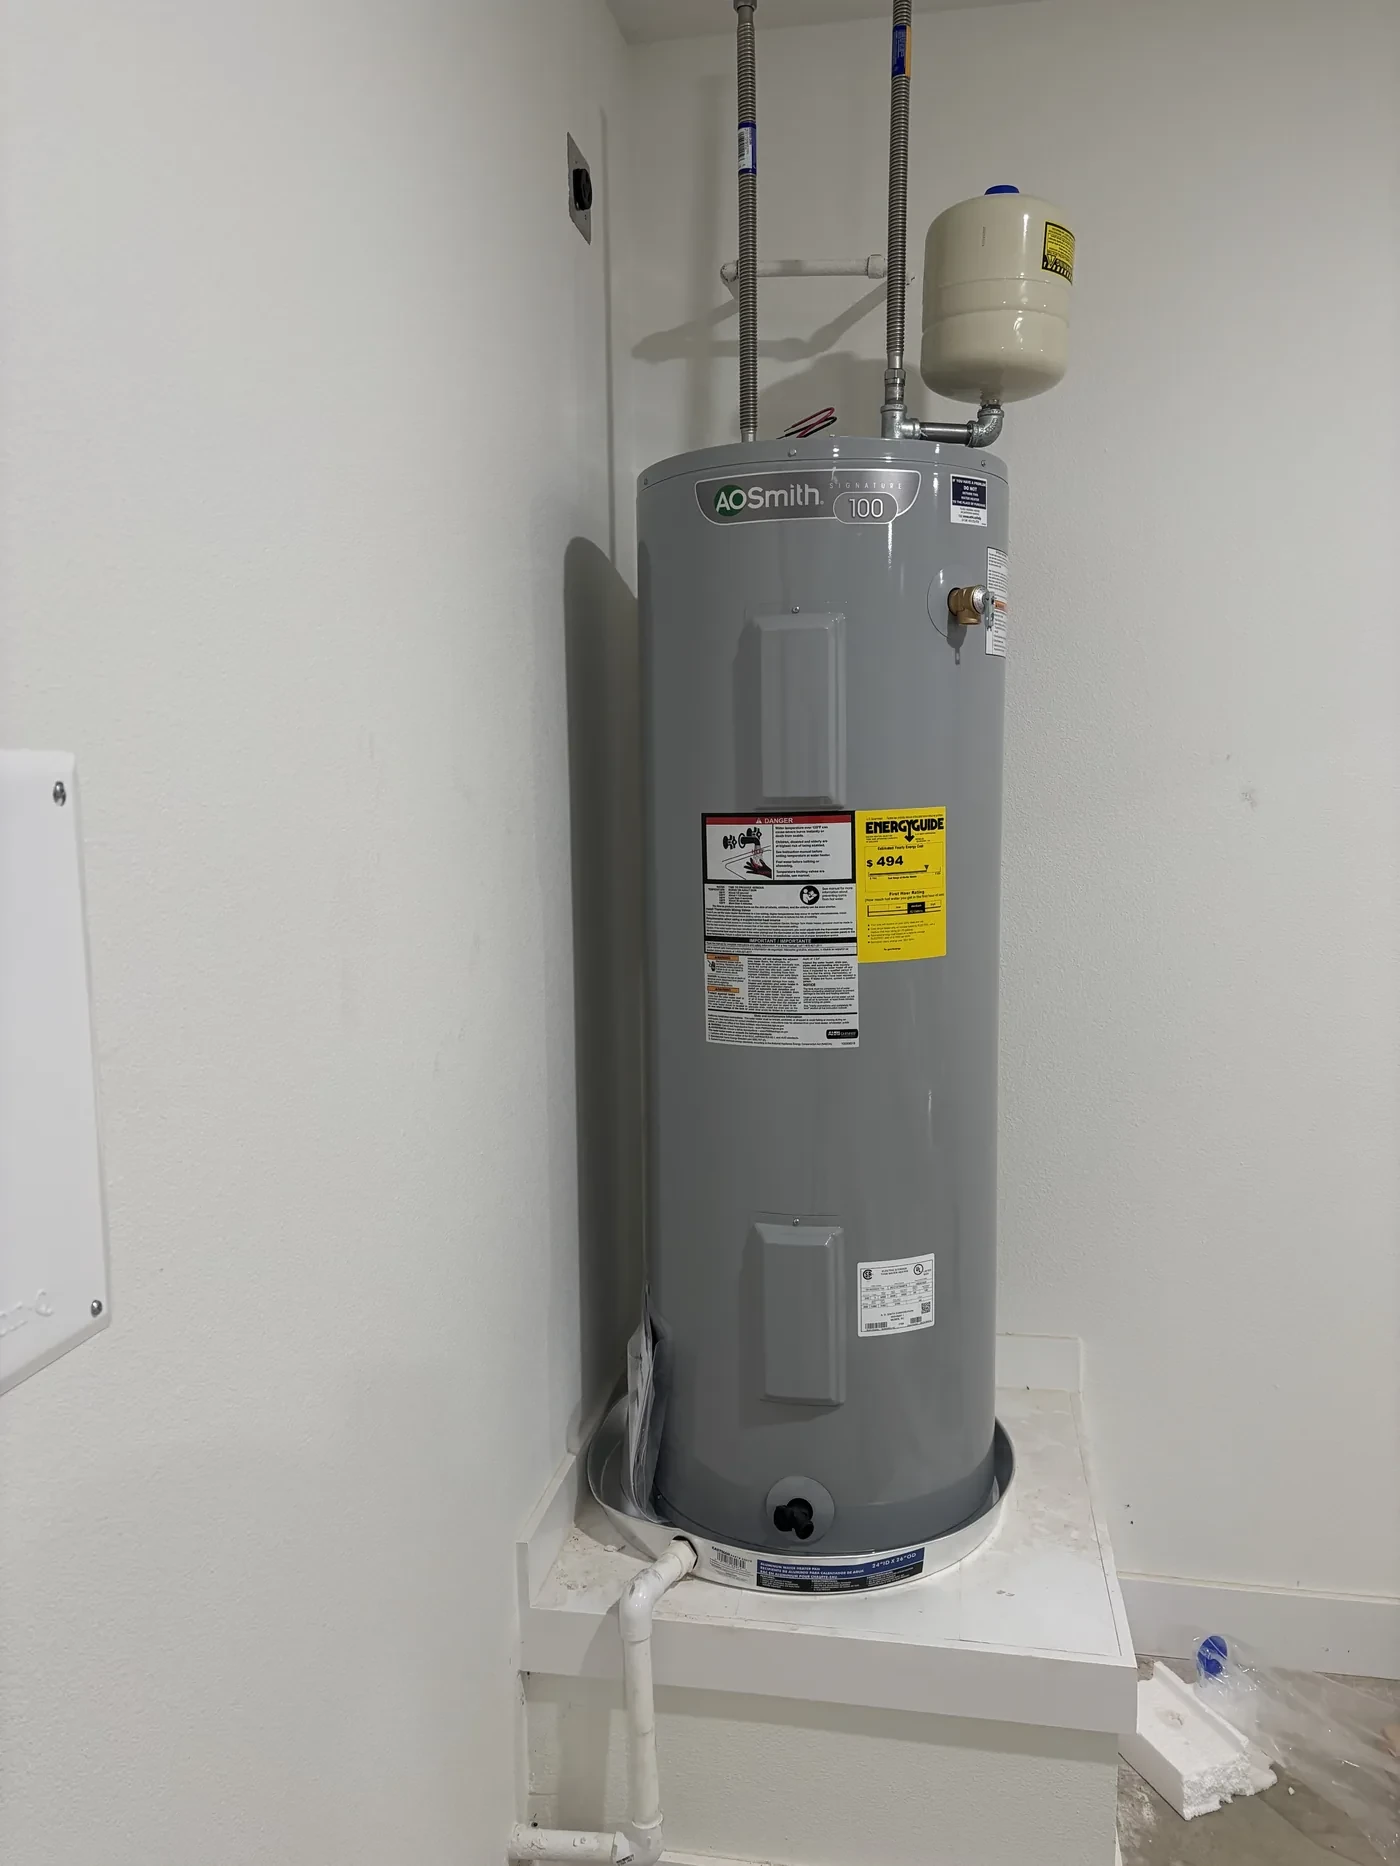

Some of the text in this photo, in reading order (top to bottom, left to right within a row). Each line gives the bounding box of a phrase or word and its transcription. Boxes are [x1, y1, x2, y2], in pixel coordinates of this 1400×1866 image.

[829, 482, 902, 490] SIGNATURE
[715, 484, 820, 513] AOSmith
[849, 498, 884, 518] 100
[866, 818, 945, 838] ENERGYGUIDE
[866, 855, 904, 868] $ 494
